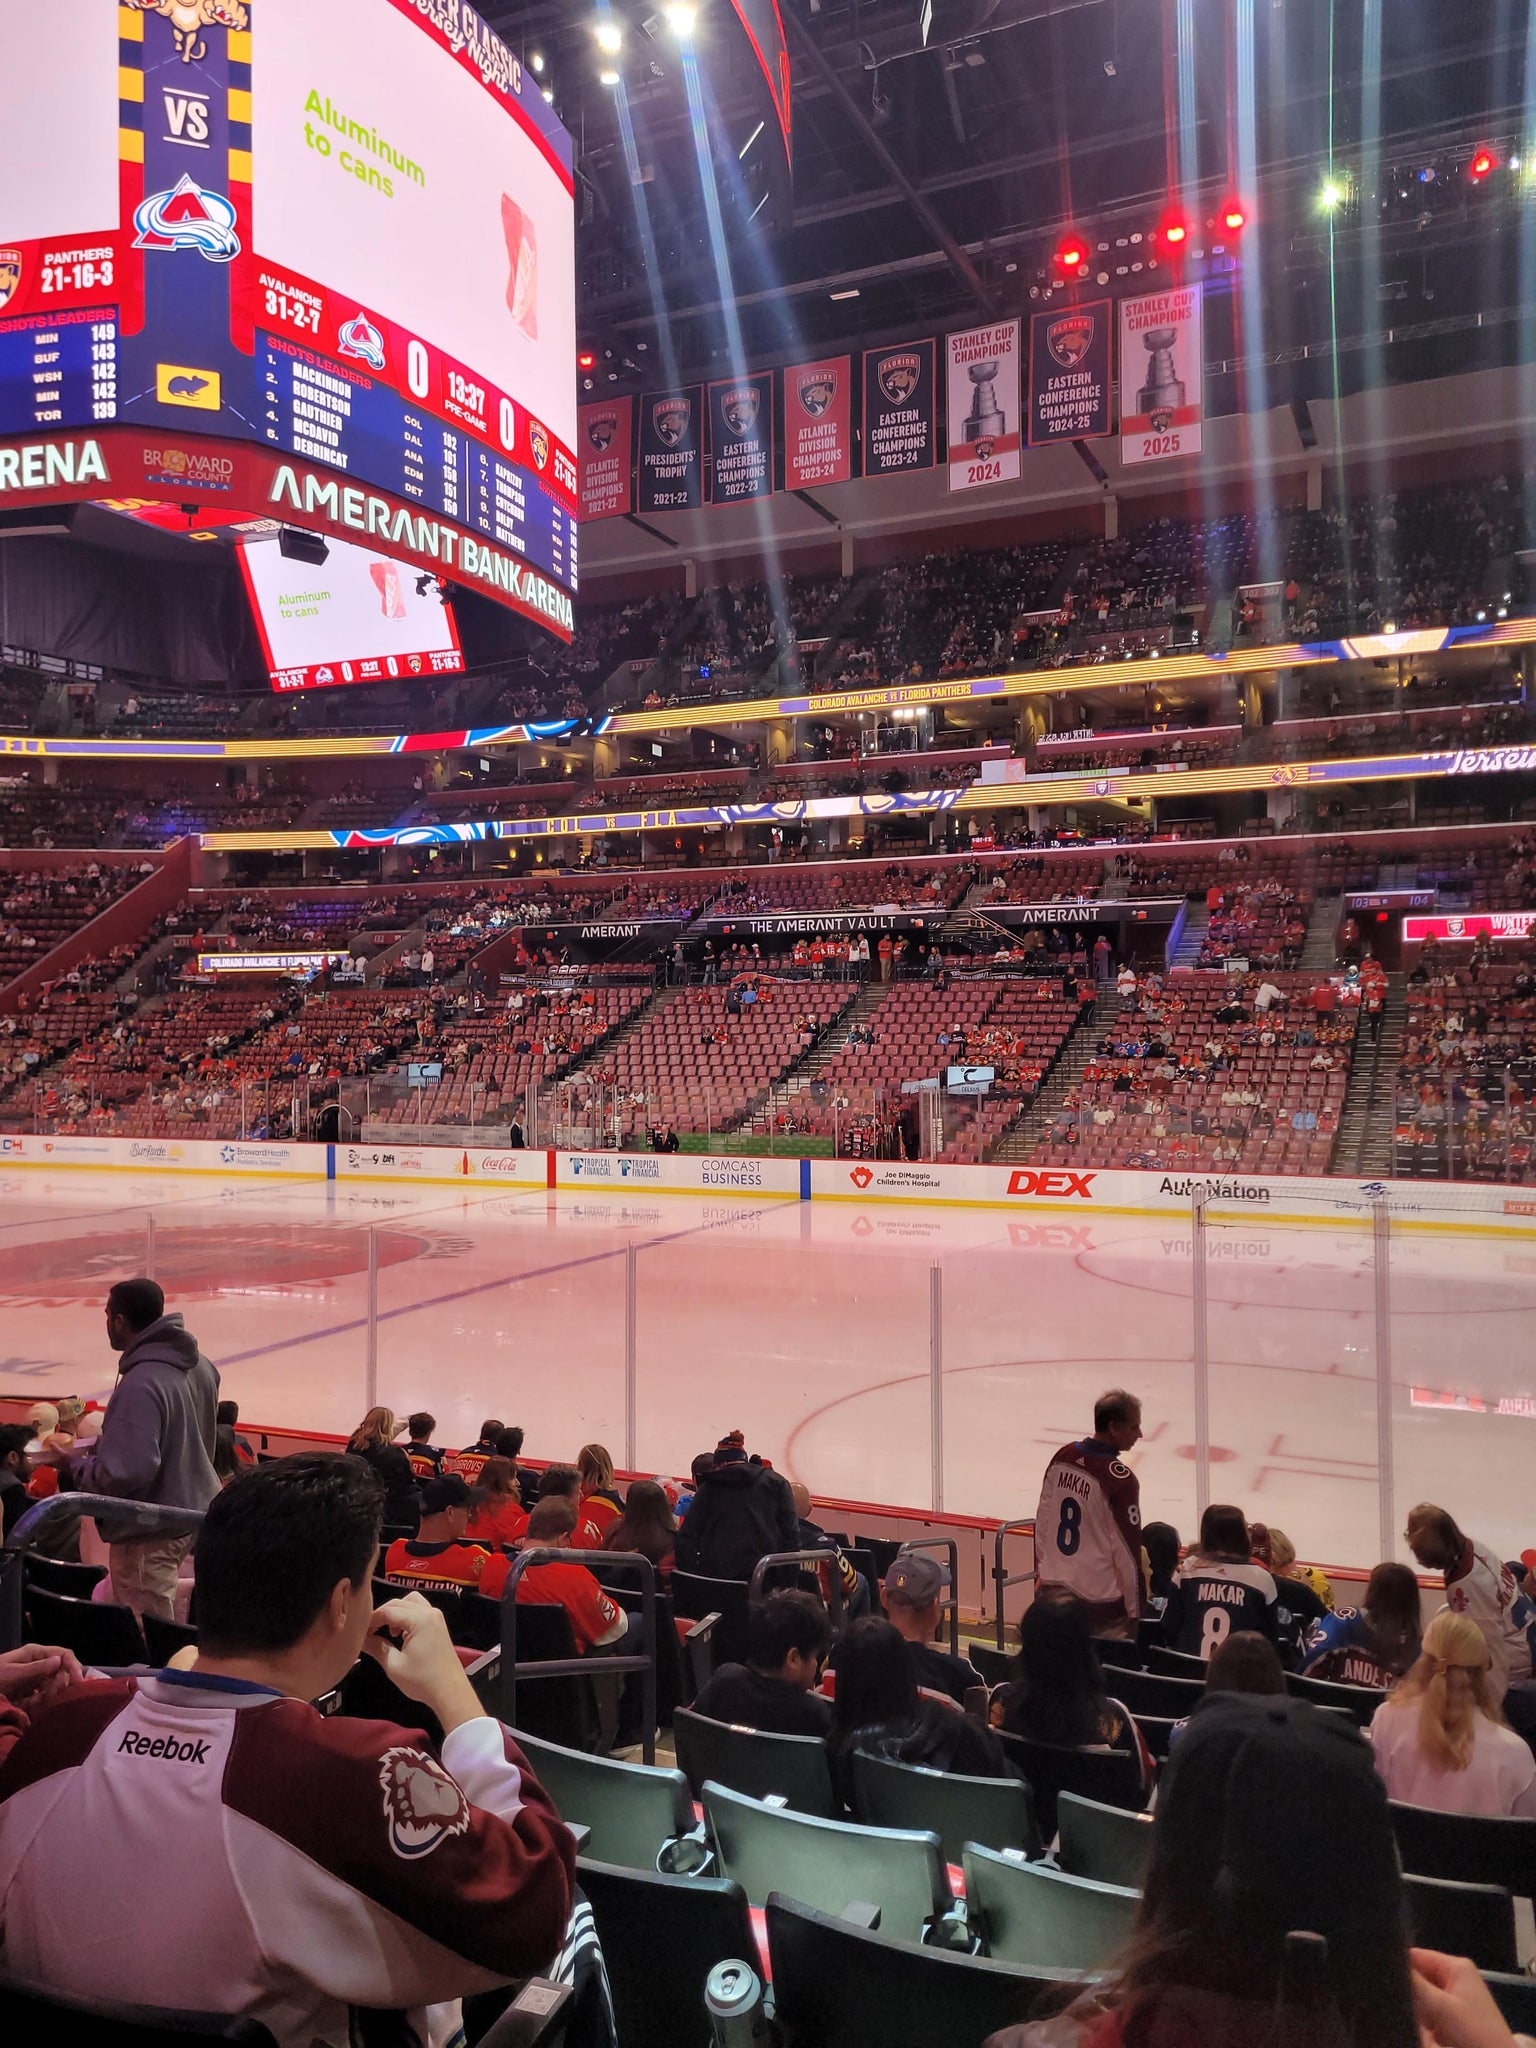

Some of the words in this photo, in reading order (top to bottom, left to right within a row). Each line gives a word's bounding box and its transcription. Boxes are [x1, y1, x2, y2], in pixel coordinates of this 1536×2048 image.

[408, 0, 465, 54] ersey
[468, 38, 508, 94] Night
[462, 5, 521, 94] CLASSIC
[165, 96, 208, 141] VS
[304, 89, 426, 188] Aluminum
[304, 122, 331, 157] to
[340, 150, 394, 198] cans
[44, 247, 114, 265] PANTHERS
[41, 261, 114, 293] 21-16-3
[259, 273, 322, 311] AVALANCHE
[265, 290, 321, 334] 31-2-7
[1125, 295, 1170, 317] STANLEY
[1174, 290, 1195, 307] CUP
[0, 316, 48, 333] SHOTS
[51, 308, 116, 324] LEADERS
[1128, 308, 1192, 331] CHAMPIONS
[35, 333, 59, 345] MIN
[91, 324, 116, 342] 149
[952, 331, 992, 351] STANLEY
[995, 326, 1015, 341] CUP
[34, 352, 60, 364] BUF
[91, 343, 116, 361] 143
[954, 340, 1012, 364] CHAMPIONS
[33, 371, 62, 384] WSH
[91, 362, 116, 380] 142
[267, 336, 314, 364] SHOTS
[316, 358, 372, 390] LEADERS
[407, 339, 429, 399] 0
[1048, 371, 1092, 390] EASTERN
[36, 391, 60, 403] MIN
[92, 382, 116, 400] 142
[266, 354, 276, 365] 1.
[292, 361, 352, 400] MACKINNON
[404, 414, 423, 431] COL
[448, 371, 486, 416] 13:37
[1039, 384, 1101, 405] CONFERENCE
[34, 410, 62, 422] TOR
[92, 401, 117, 419] 139
[265, 372, 278, 385] 2.
[292, 379, 351, 417] ROBERTSON
[404, 431, 423, 448] DAL
[445, 399, 488, 433] PRE-GAME
[879, 409, 919, 426] EASTERN
[1040, 400, 1099, 420] CHAMPIONS
[265, 391, 278, 404] 3.
[293, 398, 343, 431] GAUTHIER
[404, 449, 424, 465] ANA
[500, 397, 515, 451] 0
[798, 422, 837, 441] ATLANTIC
[871, 422, 928, 441] CONFERENCE
[1048, 416, 1091, 433] 2024-25
[265, 410, 279, 422] 4.
[293, 417, 339, 447] MCDAVID
[404, 465, 424, 481] EDM
[723, 440, 759, 457] EASTERN
[799, 436, 836, 454] DIVISION
[873, 436, 926, 455] CHAMPIONS
[1143, 434, 1181, 457] 2025
[0, 440, 109, 490] RENA
[143, 449, 234, 475] BROWARD
[266, 428, 279, 440] 5.
[293, 435, 348, 469] DEBRINCAT
[405, 482, 424, 497] DET
[586, 457, 619, 475] ATLANTIC
[644, 450, 696, 466] PRESIDENTS'
[716, 452, 766, 471] CONFERENCE
[792, 449, 842, 468] CHAMPIONS
[880, 451, 918, 467] 2023-24
[188, 470, 232, 482] COUNTY
[586, 471, 619, 487] DIVISION
[654, 465, 687, 479] TROPHY
[717, 466, 765, 484] CHAMPIONS
[800, 464, 834, 480] 2023-24
[967, 462, 1001, 484] 2024
[148, 475, 230, 490] FLORIDA
[582, 482, 623, 502] CHAMPIONS
[725, 480, 758, 497] 2022-23
[588, 497, 617, 514] 2021-22
[653, 492, 688, 505] 2021-22
[270, 465, 459, 564] AMERANT
[462, 536, 525, 596] BANK
[525, 571, 575, 632] ARENA
[278, 590, 331, 606] Aluminum
[281, 608, 292, 619] to
[295, 606, 319, 618] cans
[341, 662, 353, 681] 0
[387, 656, 398, 676] 0
[808, 696, 846, 710] COLORADO
[846, 692, 888, 707] AVALANCHE
[890, 691, 898, 700] VS
[900, 688, 930, 701] FLORIDA
[931, 684, 972, 698] PANTHERS
[606, 817, 616, 829] VS
[640, 811, 677, 828] FLA
[1351, 897, 1369, 908] 103
[1409, 895, 1428, 906] 104
[749, 921, 773, 933] THE
[776, 918, 843, 932] AMERANT
[847, 916, 897, 930] VAULT
[1022, 907, 1100, 922] AMERANT
[581, 924, 641, 938] AMERANT
[209, 958, 241, 968] COLORADO
[243, 957, 279, 967] AVALANCHE
[130, 1142, 166, 1158] Surfside
[237, 1147, 268, 1157] Broward
[268, 1148, 290, 1158] Health
[584, 1158, 610, 1168] TROPICAL
[584, 1166, 612, 1176] FINANCIAL
[632, 1159, 660, 1169] TROPICAL
[632, 1167, 661, 1178] FINANCIAL
[701, 1160, 762, 1172] COMCAST
[702, 1173, 762, 1185] BUSINESS
[876, 1178, 910, 1187] Children's
[911, 1180, 941, 1188] Hospital
[898, 1171, 931, 1180] DiMaggio
[1006, 1170, 1098, 1198] DEX
[1057, 1471, 1091, 1501] MAKAR
[1127, 1504, 1139, 1526] 8
[1056, 1496, 1081, 1556] 8
[1198, 1583, 1245, 1607] MAKAR
[1199, 1606, 1231, 1661] 8
[117, 1730, 212, 1764] Reebok
